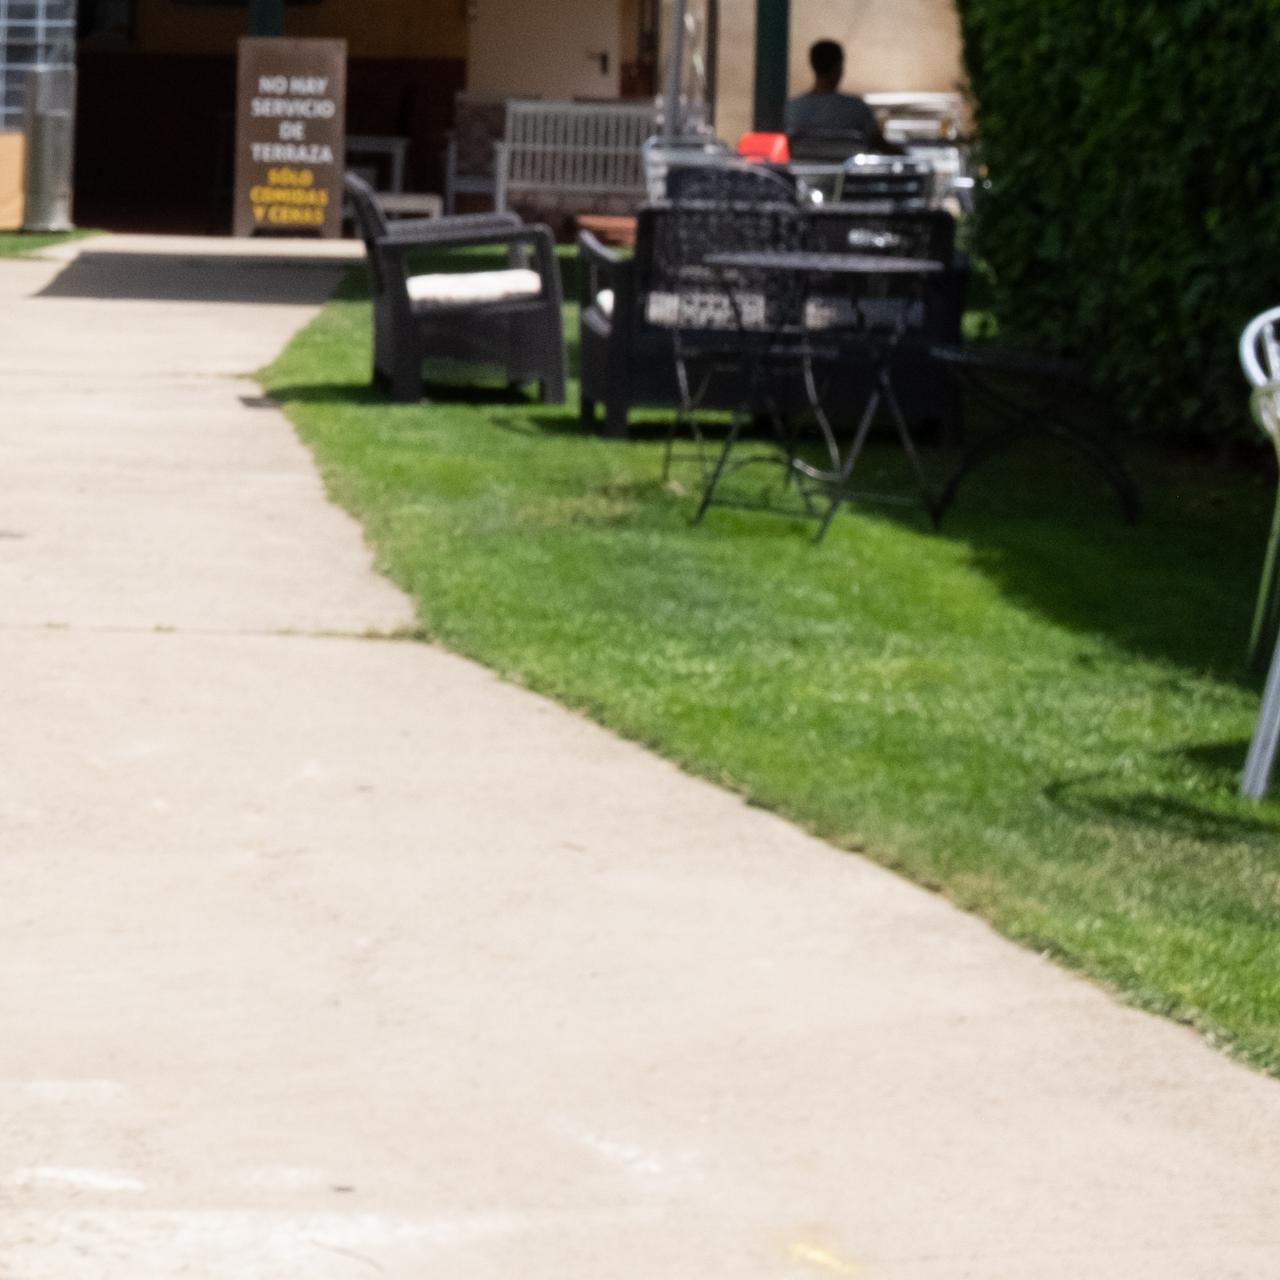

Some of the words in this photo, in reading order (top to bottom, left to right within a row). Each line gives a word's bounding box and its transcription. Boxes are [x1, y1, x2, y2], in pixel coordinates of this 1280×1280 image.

[258, 75, 288, 96] NO
[290, 76, 329, 96] HAY
[250, 97, 337, 119] SERVICIO
[278, 121, 306, 141] DE
[250, 142, 335, 163] TERRAZA
